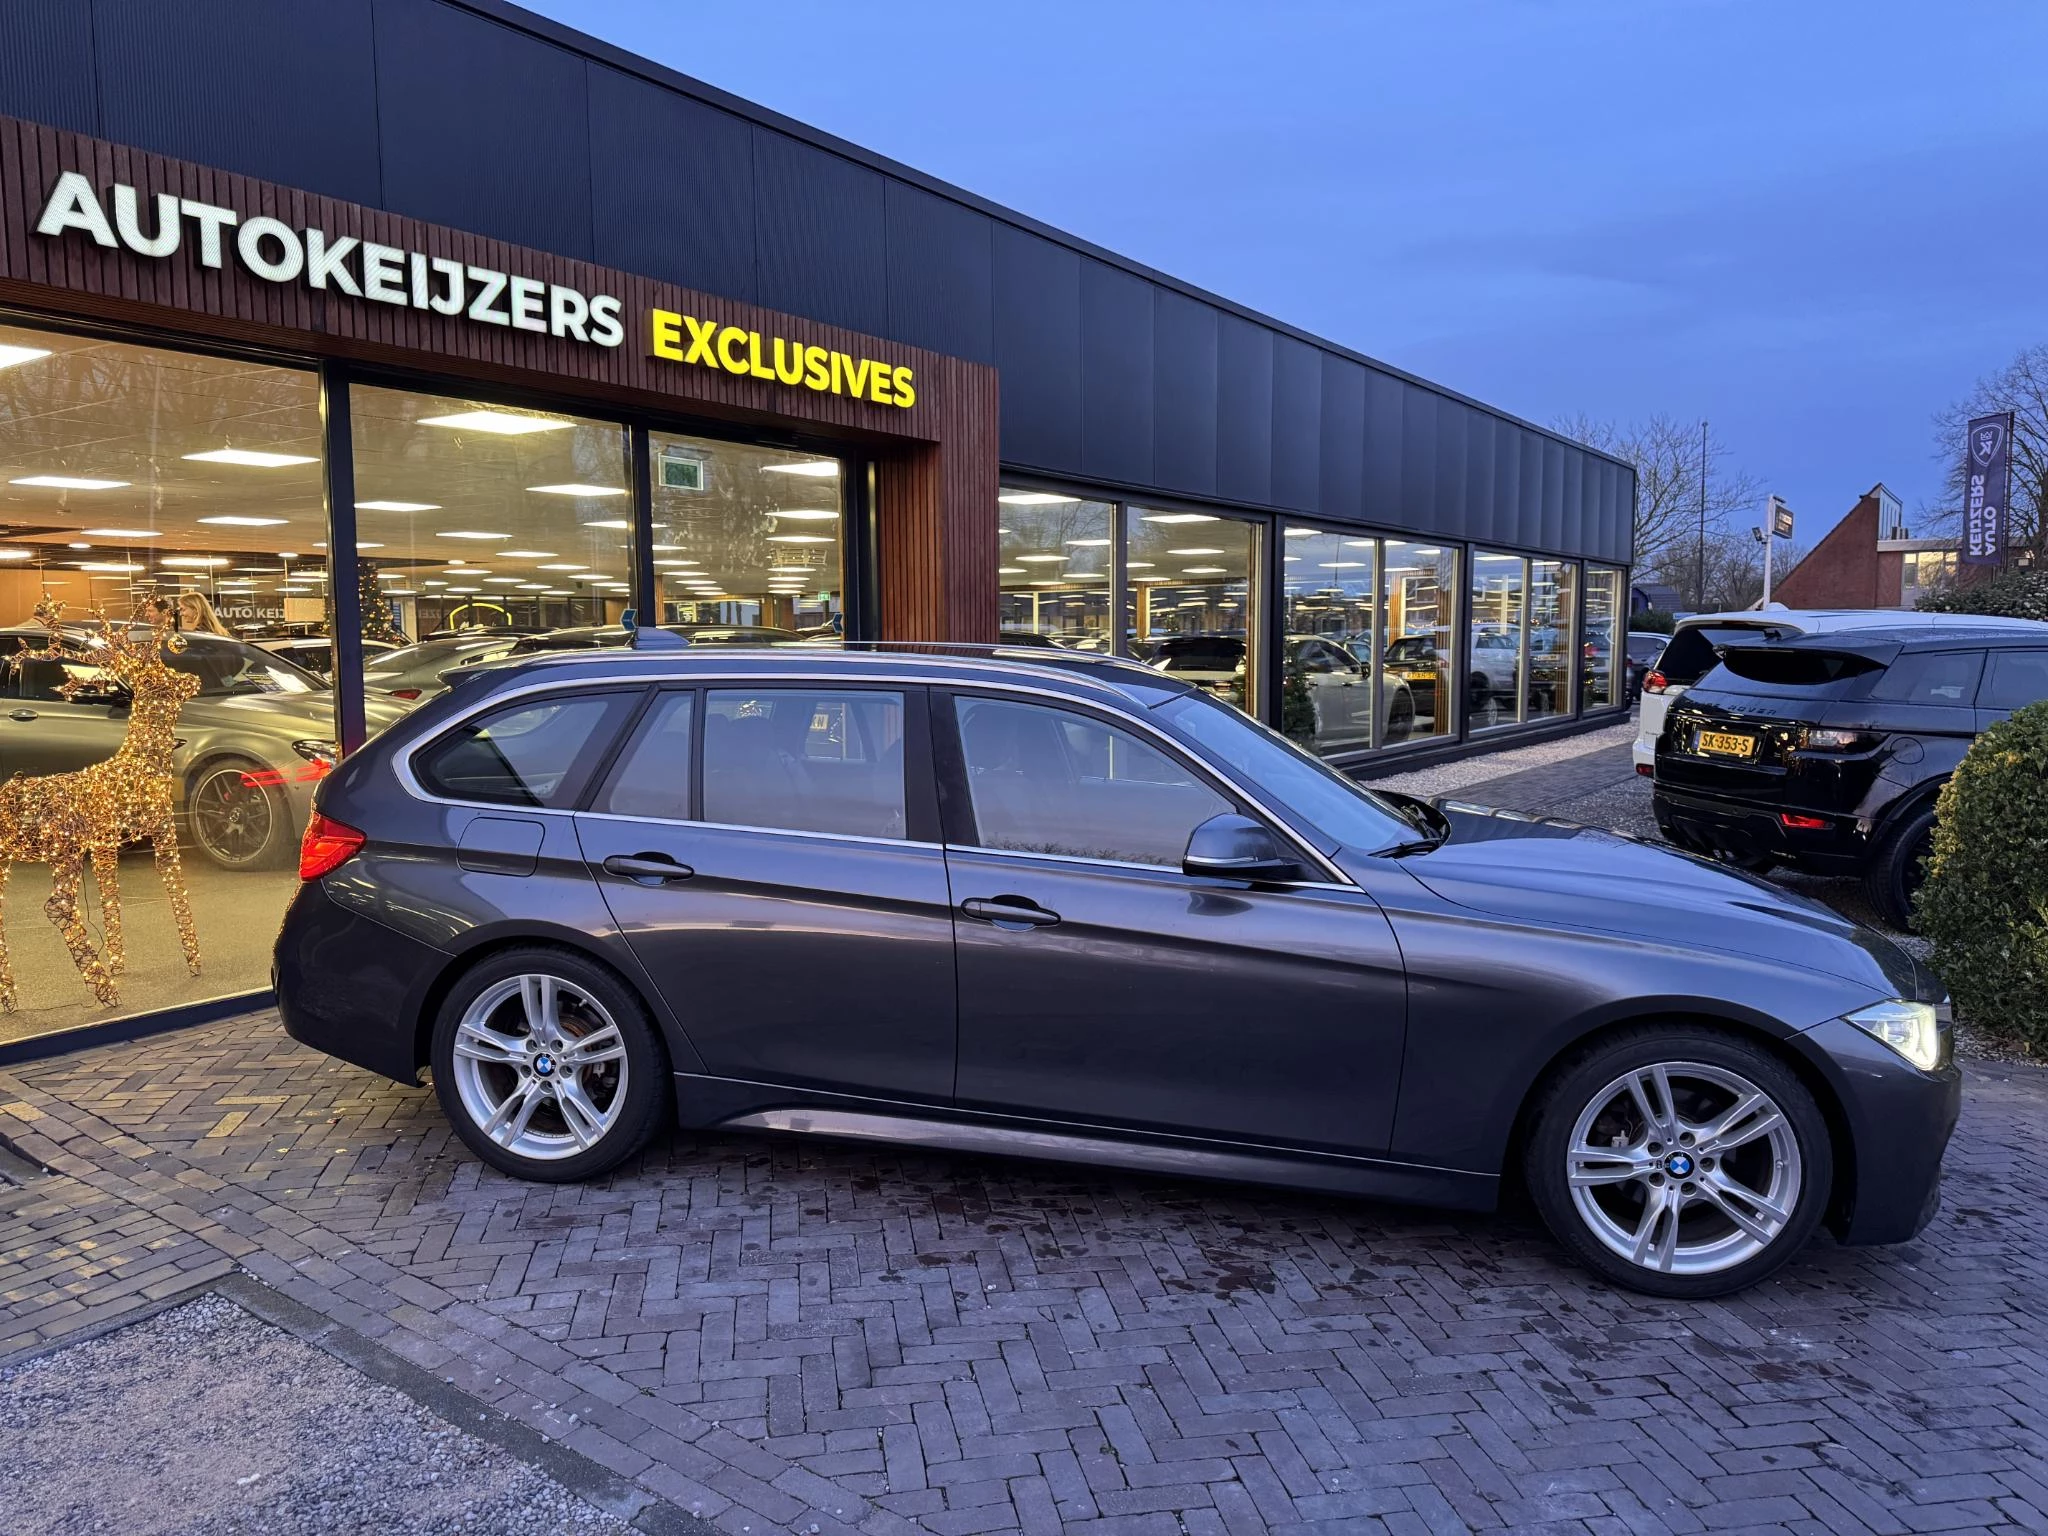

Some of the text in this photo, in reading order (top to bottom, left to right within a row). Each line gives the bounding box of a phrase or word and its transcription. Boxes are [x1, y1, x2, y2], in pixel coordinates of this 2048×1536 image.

[36, 171, 916, 408] AUTOKEIJZERS EXCLUSIVES
[215, 607, 252, 618] AUTO
[1702, 734, 1749, 752] SK-353-S
